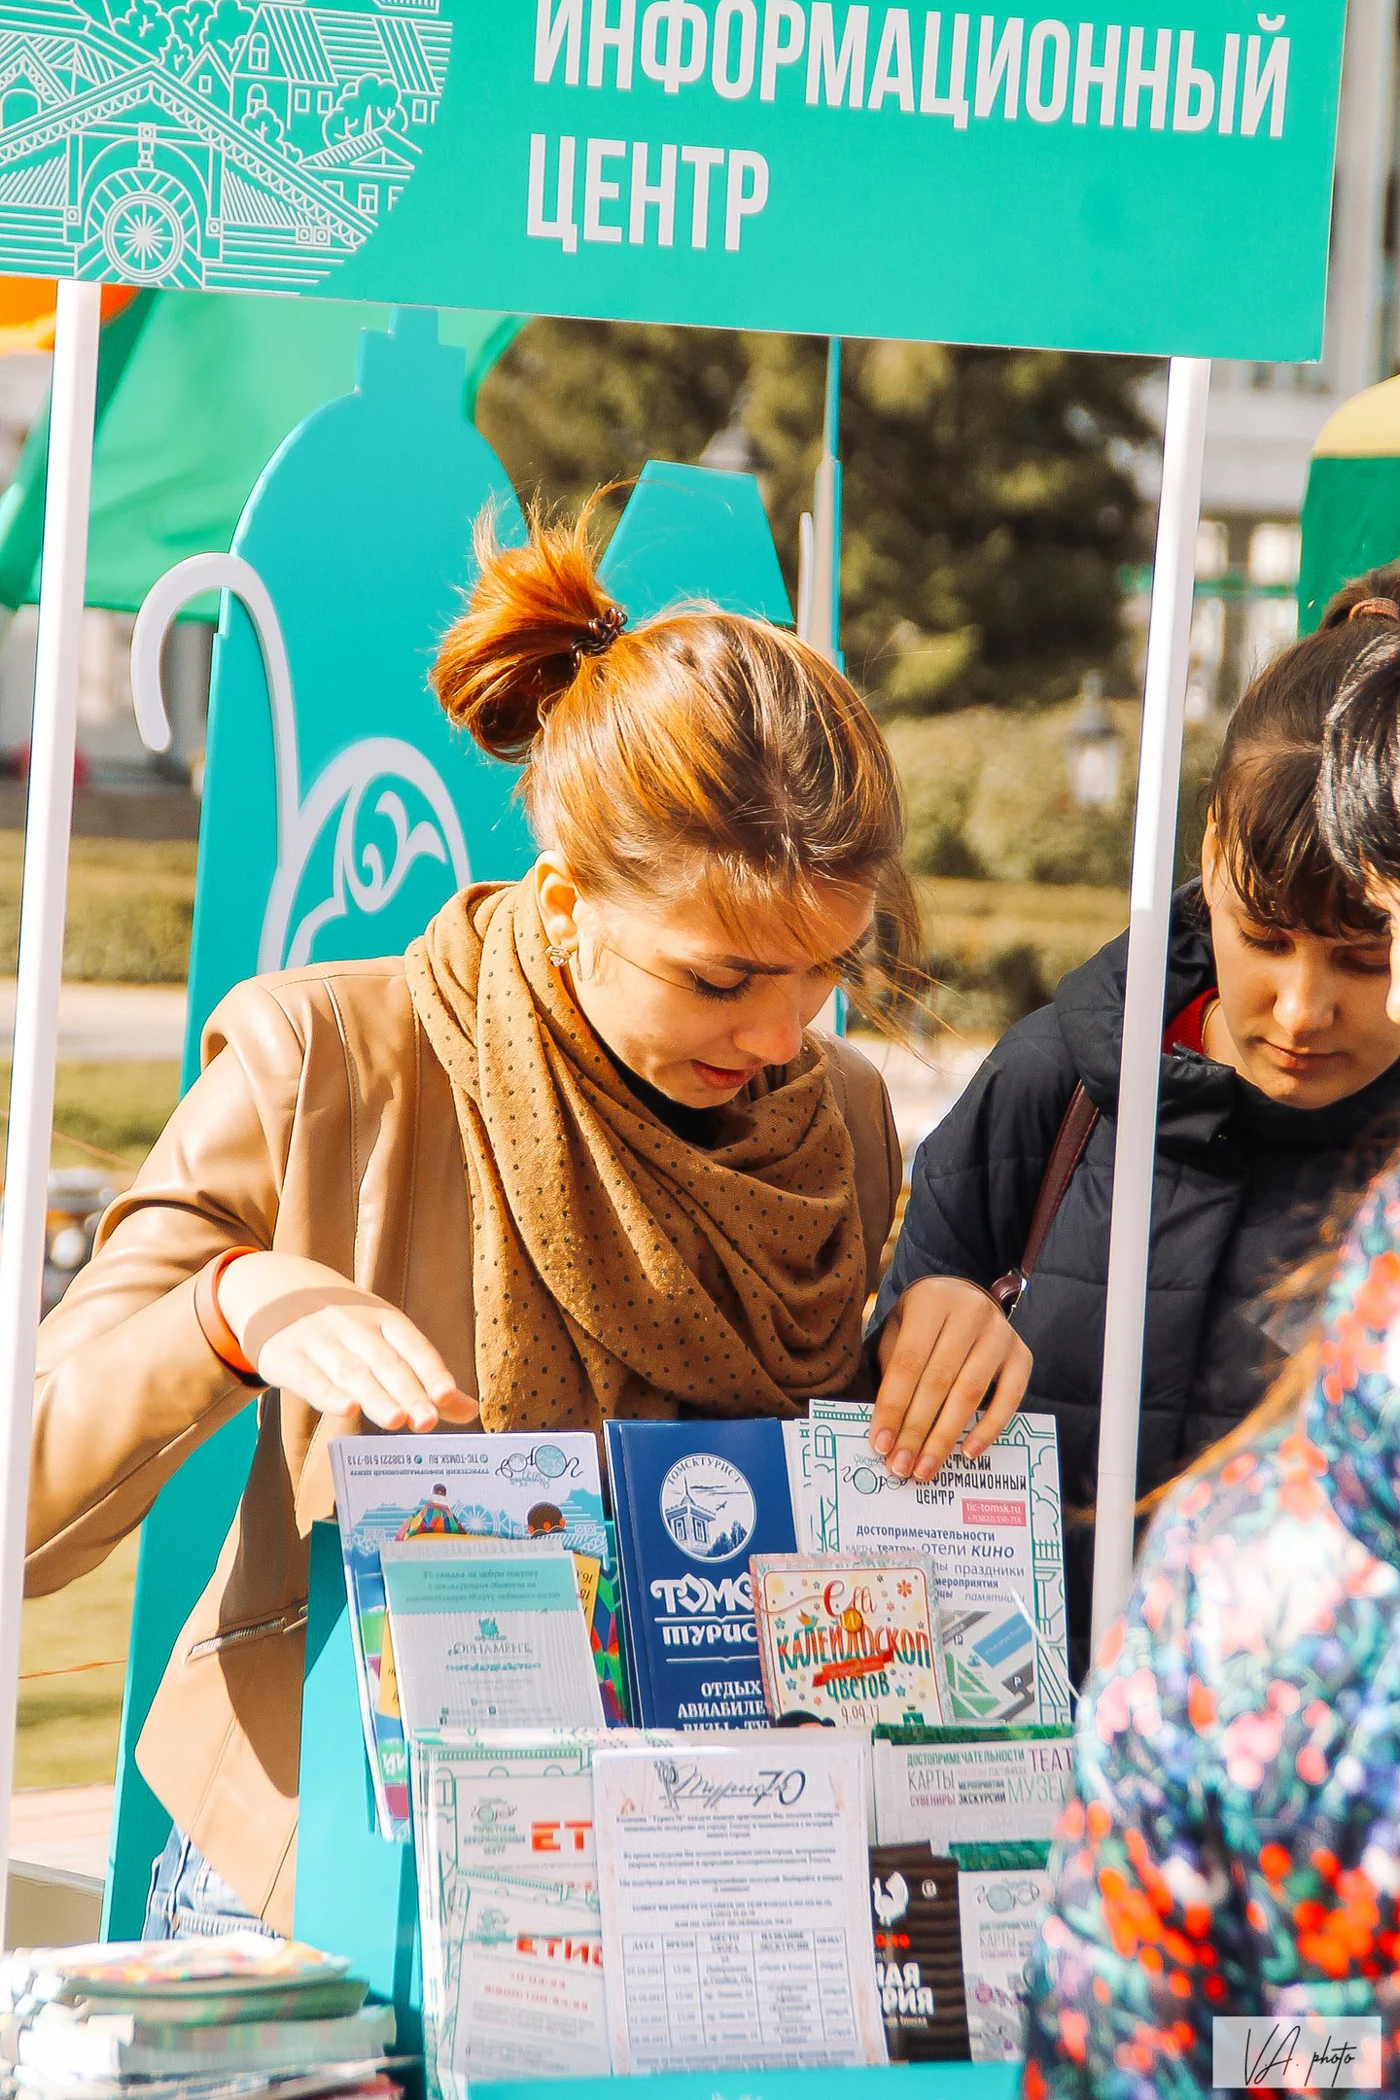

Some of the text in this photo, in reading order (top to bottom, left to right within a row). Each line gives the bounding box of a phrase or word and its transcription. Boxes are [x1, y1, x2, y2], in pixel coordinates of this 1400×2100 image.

[533, 0, 1291, 138] ИНФОРМАЦИОННЫЙ
[526, 133, 770, 253] ЦЕНТР
[667, 1456, 742, 1485] ТОМСКТУРИСТ
[915, 1471, 1027, 1491] ФОРМАЦИОННЫЙ
[916, 1489, 955, 1506] ЦЕНТР
[966, 1502, 1021, 1514] tic-tomsk.ru
[856, 1525, 995, 1542] достопримечательности
[921, 1542, 966, 1556] отели
[971, 1545, 1015, 1558] кино
[954, 1563, 1025, 1577] праздники
[701, 1680, 762, 1699] ОТДЫХ
[678, 1700, 766, 1719] АВИАБИЛЕ
[907, 1749, 1025, 1766] ДОСТОПРИМЕЧАТЕЛЬНОСТИ
[908, 1770, 955, 1791] КАРТЫ
[910, 1791, 1006, 1807] СУВЕНИРЫ ЭКСКУРСИИ
